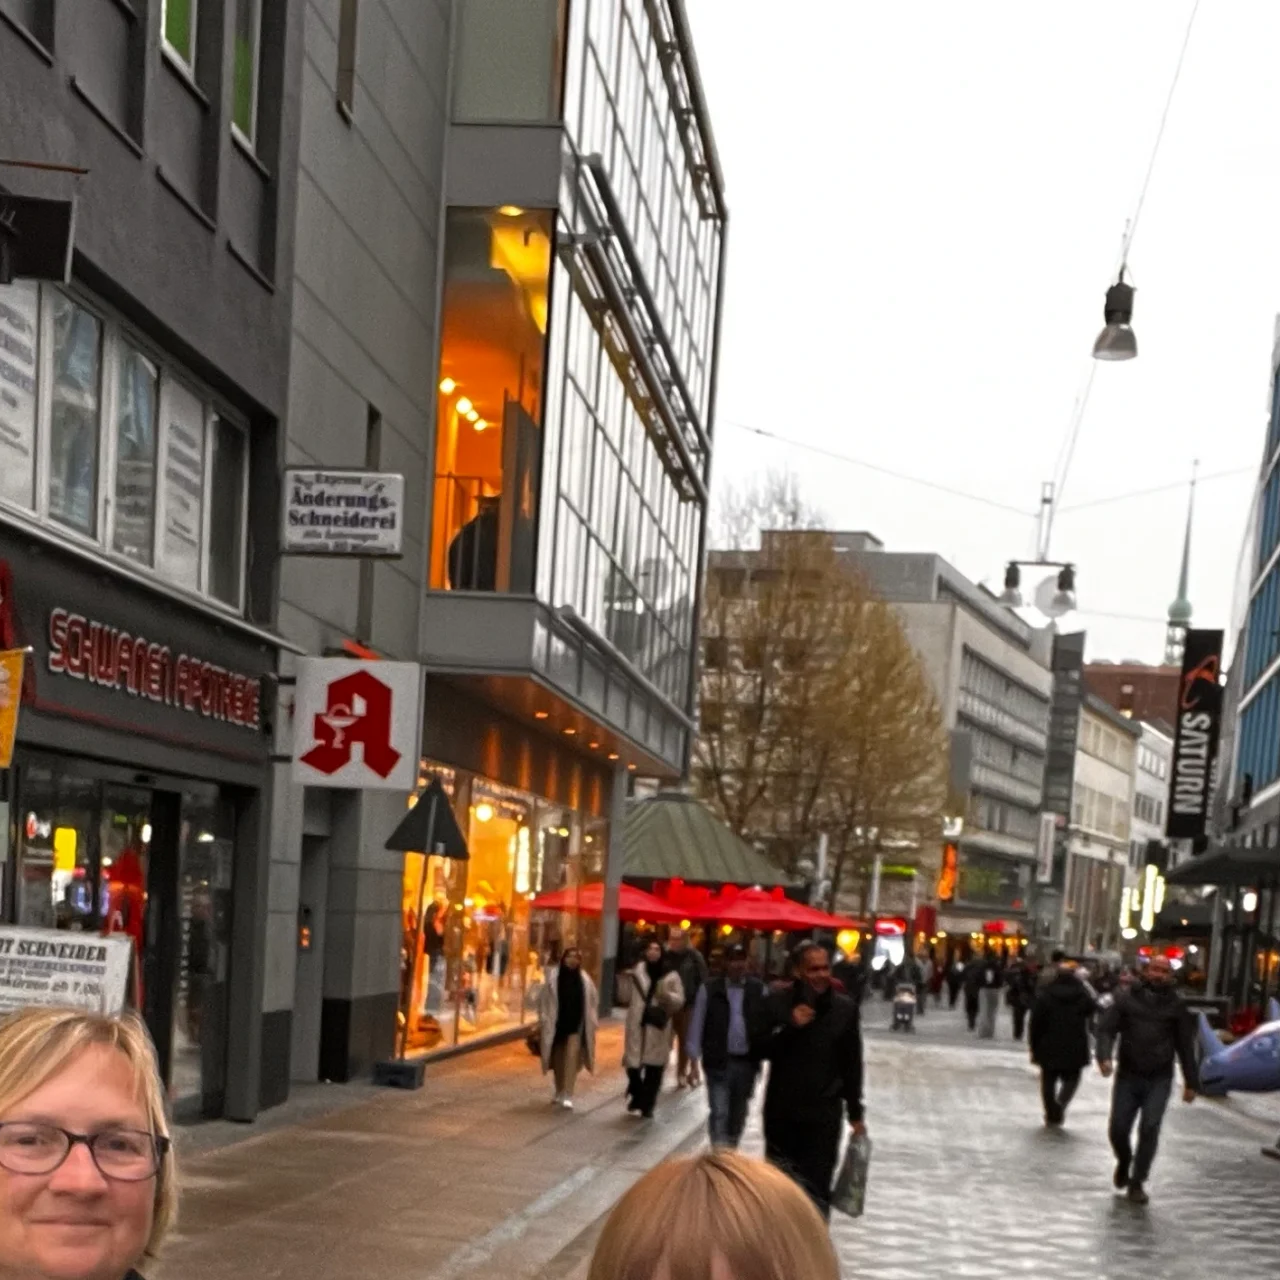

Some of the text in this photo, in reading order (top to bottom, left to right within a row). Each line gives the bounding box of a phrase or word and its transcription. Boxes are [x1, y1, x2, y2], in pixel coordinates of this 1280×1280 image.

[288, 509, 396, 529] Schneiderei
[49, 607, 260, 731] SCHWANEN APOTHEKE
[1172, 711, 1212, 814] SATURN
[18, 939, 108, 962] SCHNEIDER
